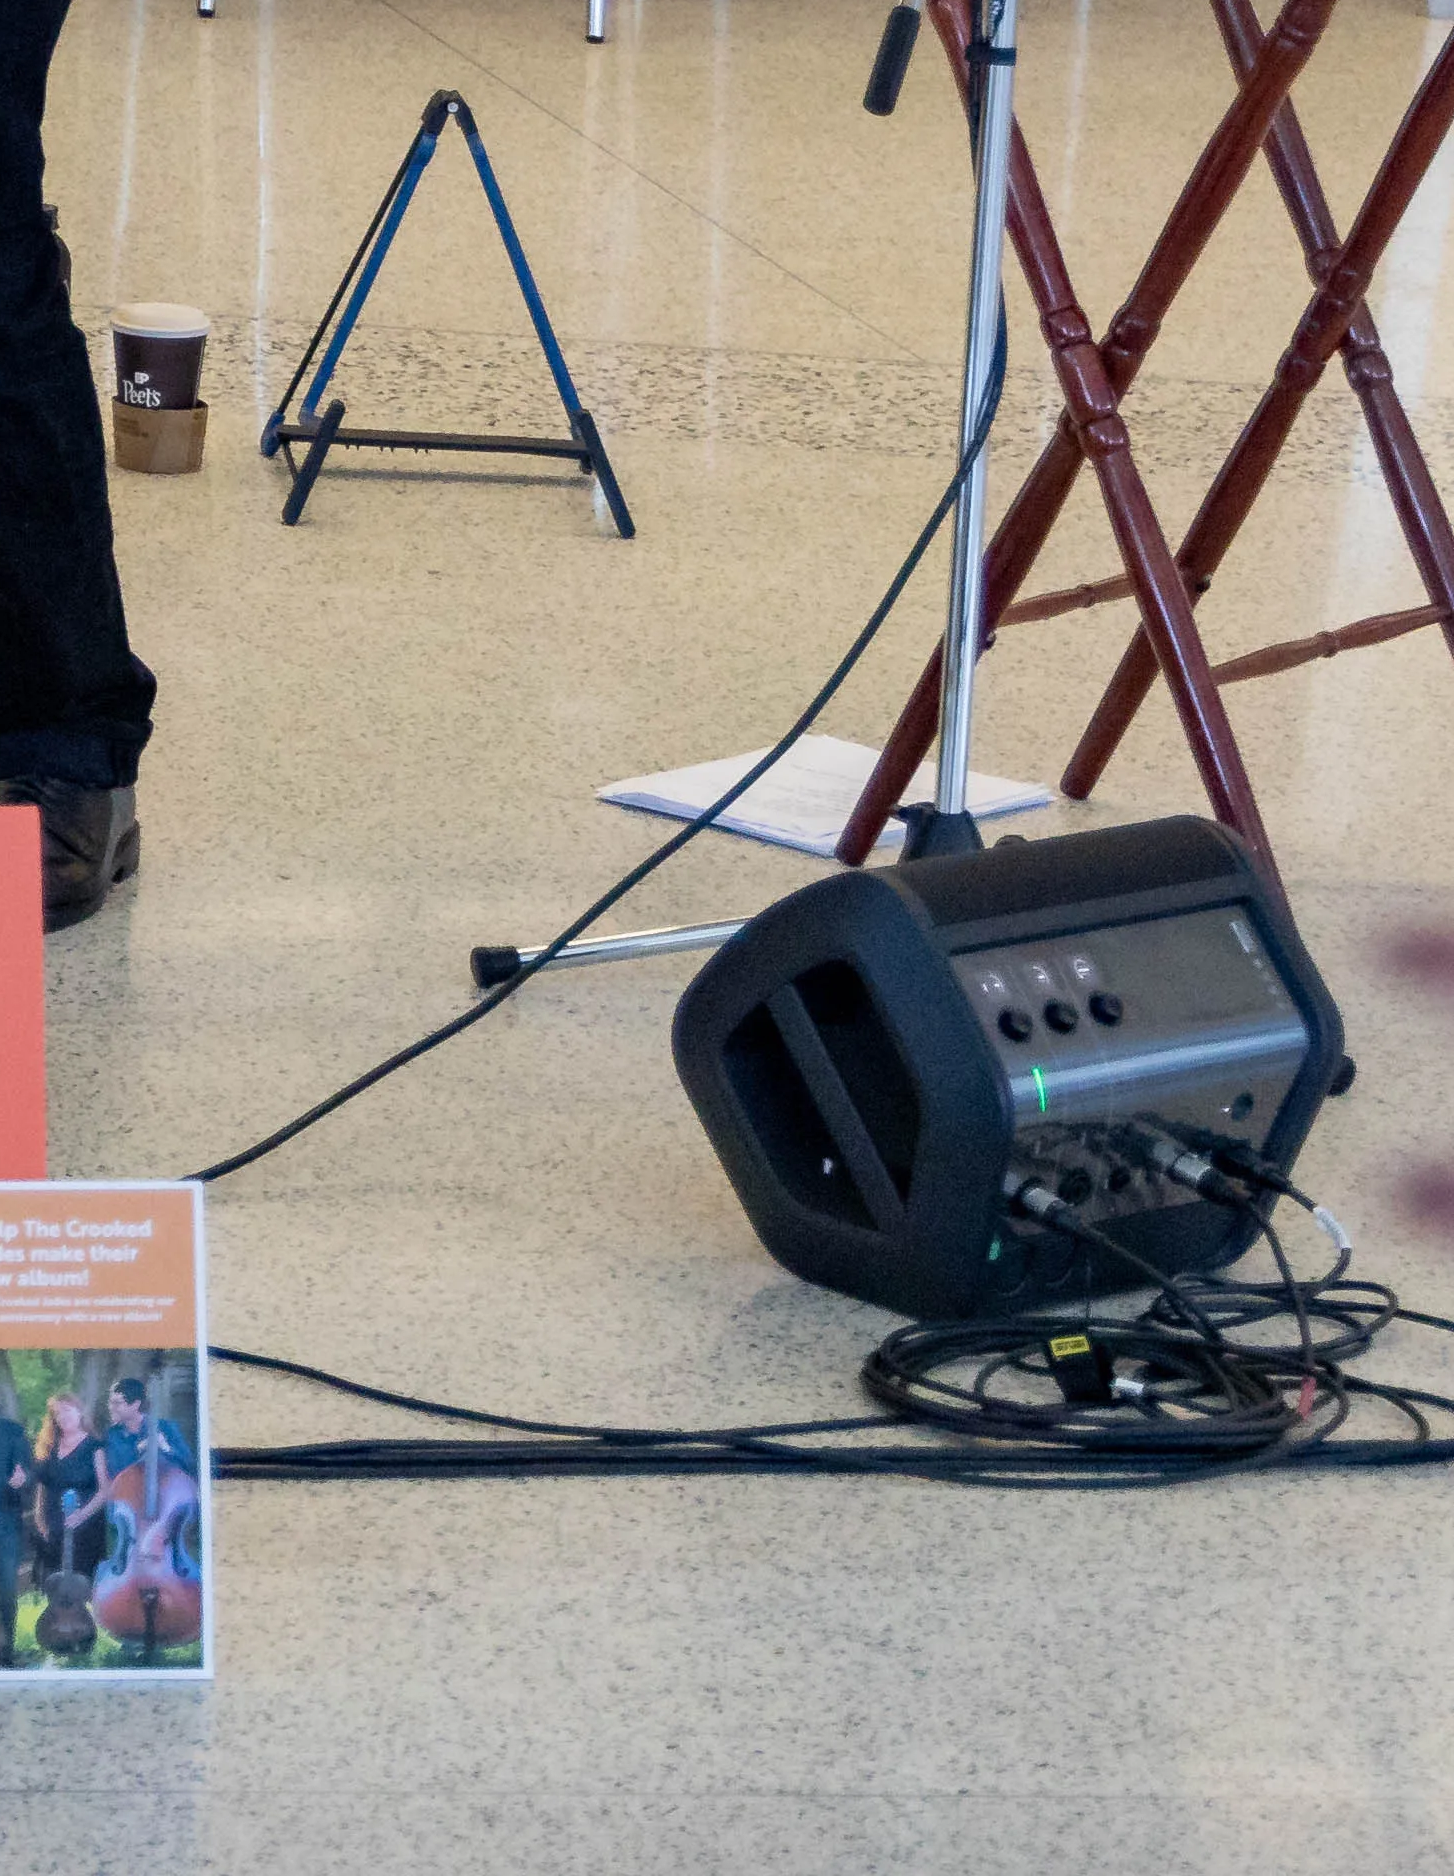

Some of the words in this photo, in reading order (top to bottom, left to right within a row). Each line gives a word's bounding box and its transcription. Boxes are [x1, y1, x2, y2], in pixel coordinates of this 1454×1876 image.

[123, 379, 162, 408] Peet's
[24, 1219, 61, 1239] The
[66, 1218, 153, 1239] Crooked
[30, 1244, 86, 1263] make
[90, 1244, 139, 1263] their
[17, 1268, 90, 1288] album!
